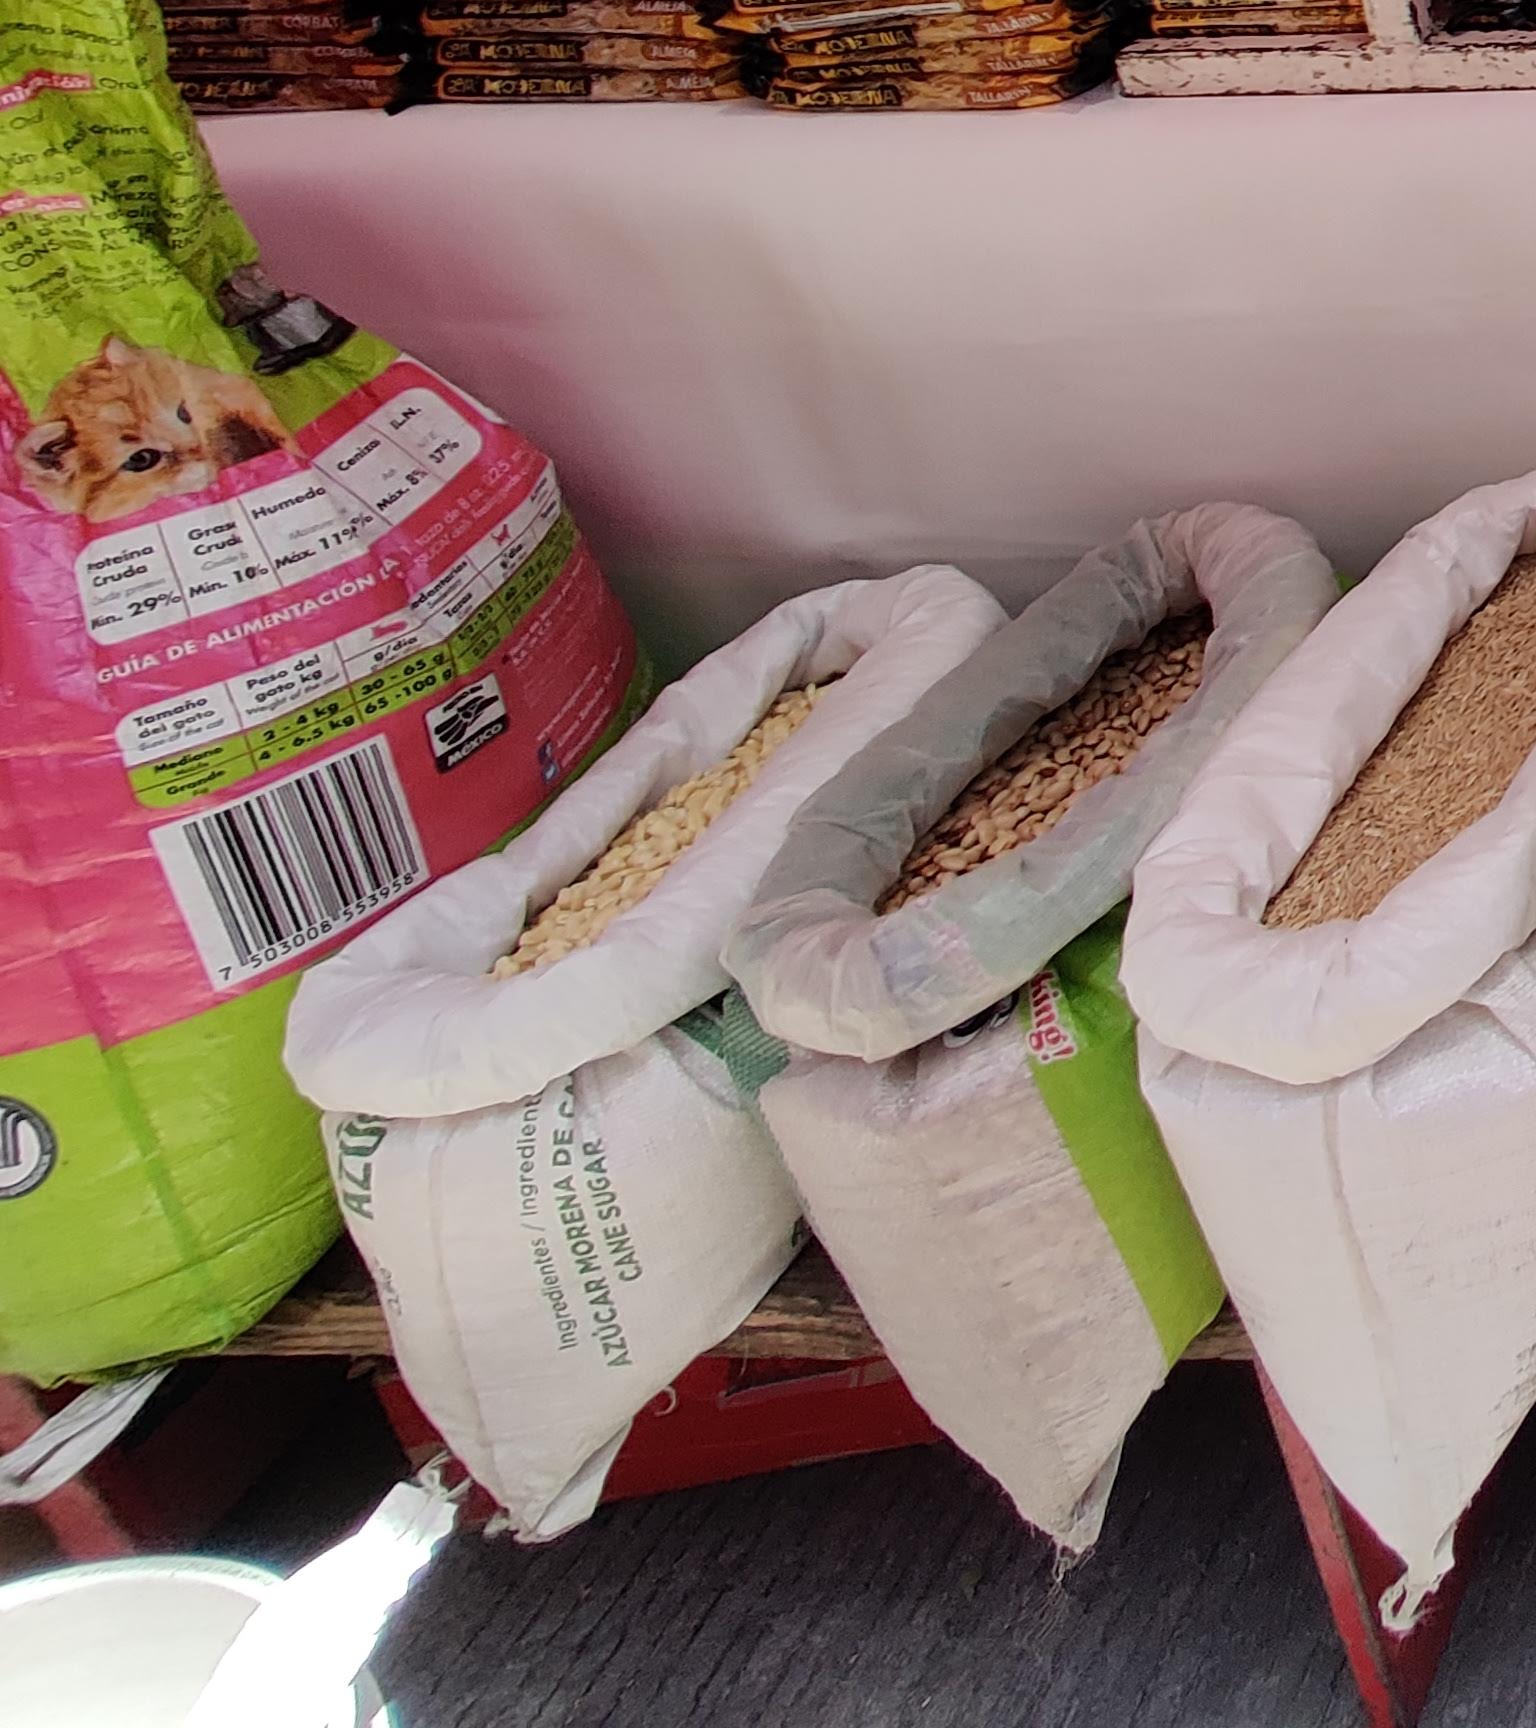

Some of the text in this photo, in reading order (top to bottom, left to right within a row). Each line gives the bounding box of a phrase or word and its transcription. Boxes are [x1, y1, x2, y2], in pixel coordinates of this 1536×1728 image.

[92, 565, 149, 587] Cruda
[274, 547, 318, 571] Máx.
[127, 591, 182, 617] 29%
[97, 652, 161, 684] GUÍA
[166, 642, 198, 661] DE
[205, 575, 377, 647] ALIMENTACIÓN
[245, 653, 321, 691] Peso del
[254, 668, 324, 704] gato kg
[132, 696, 208, 728] Tamaño
[137, 708, 217, 740] del gato
[152, 744, 225, 775] Mediano
[165, 768, 227, 797] Grande
[217, 871, 416, 983] 7 503008 553958
[1027, 969, 1078, 1065] king!
[515, 1090, 577, 1351] Ingredientes Ingredient
[581, 1137, 644, 1284] CANE SUGAR
[551, 1128, 632, 1369] AZÚCAR MORENA DE
